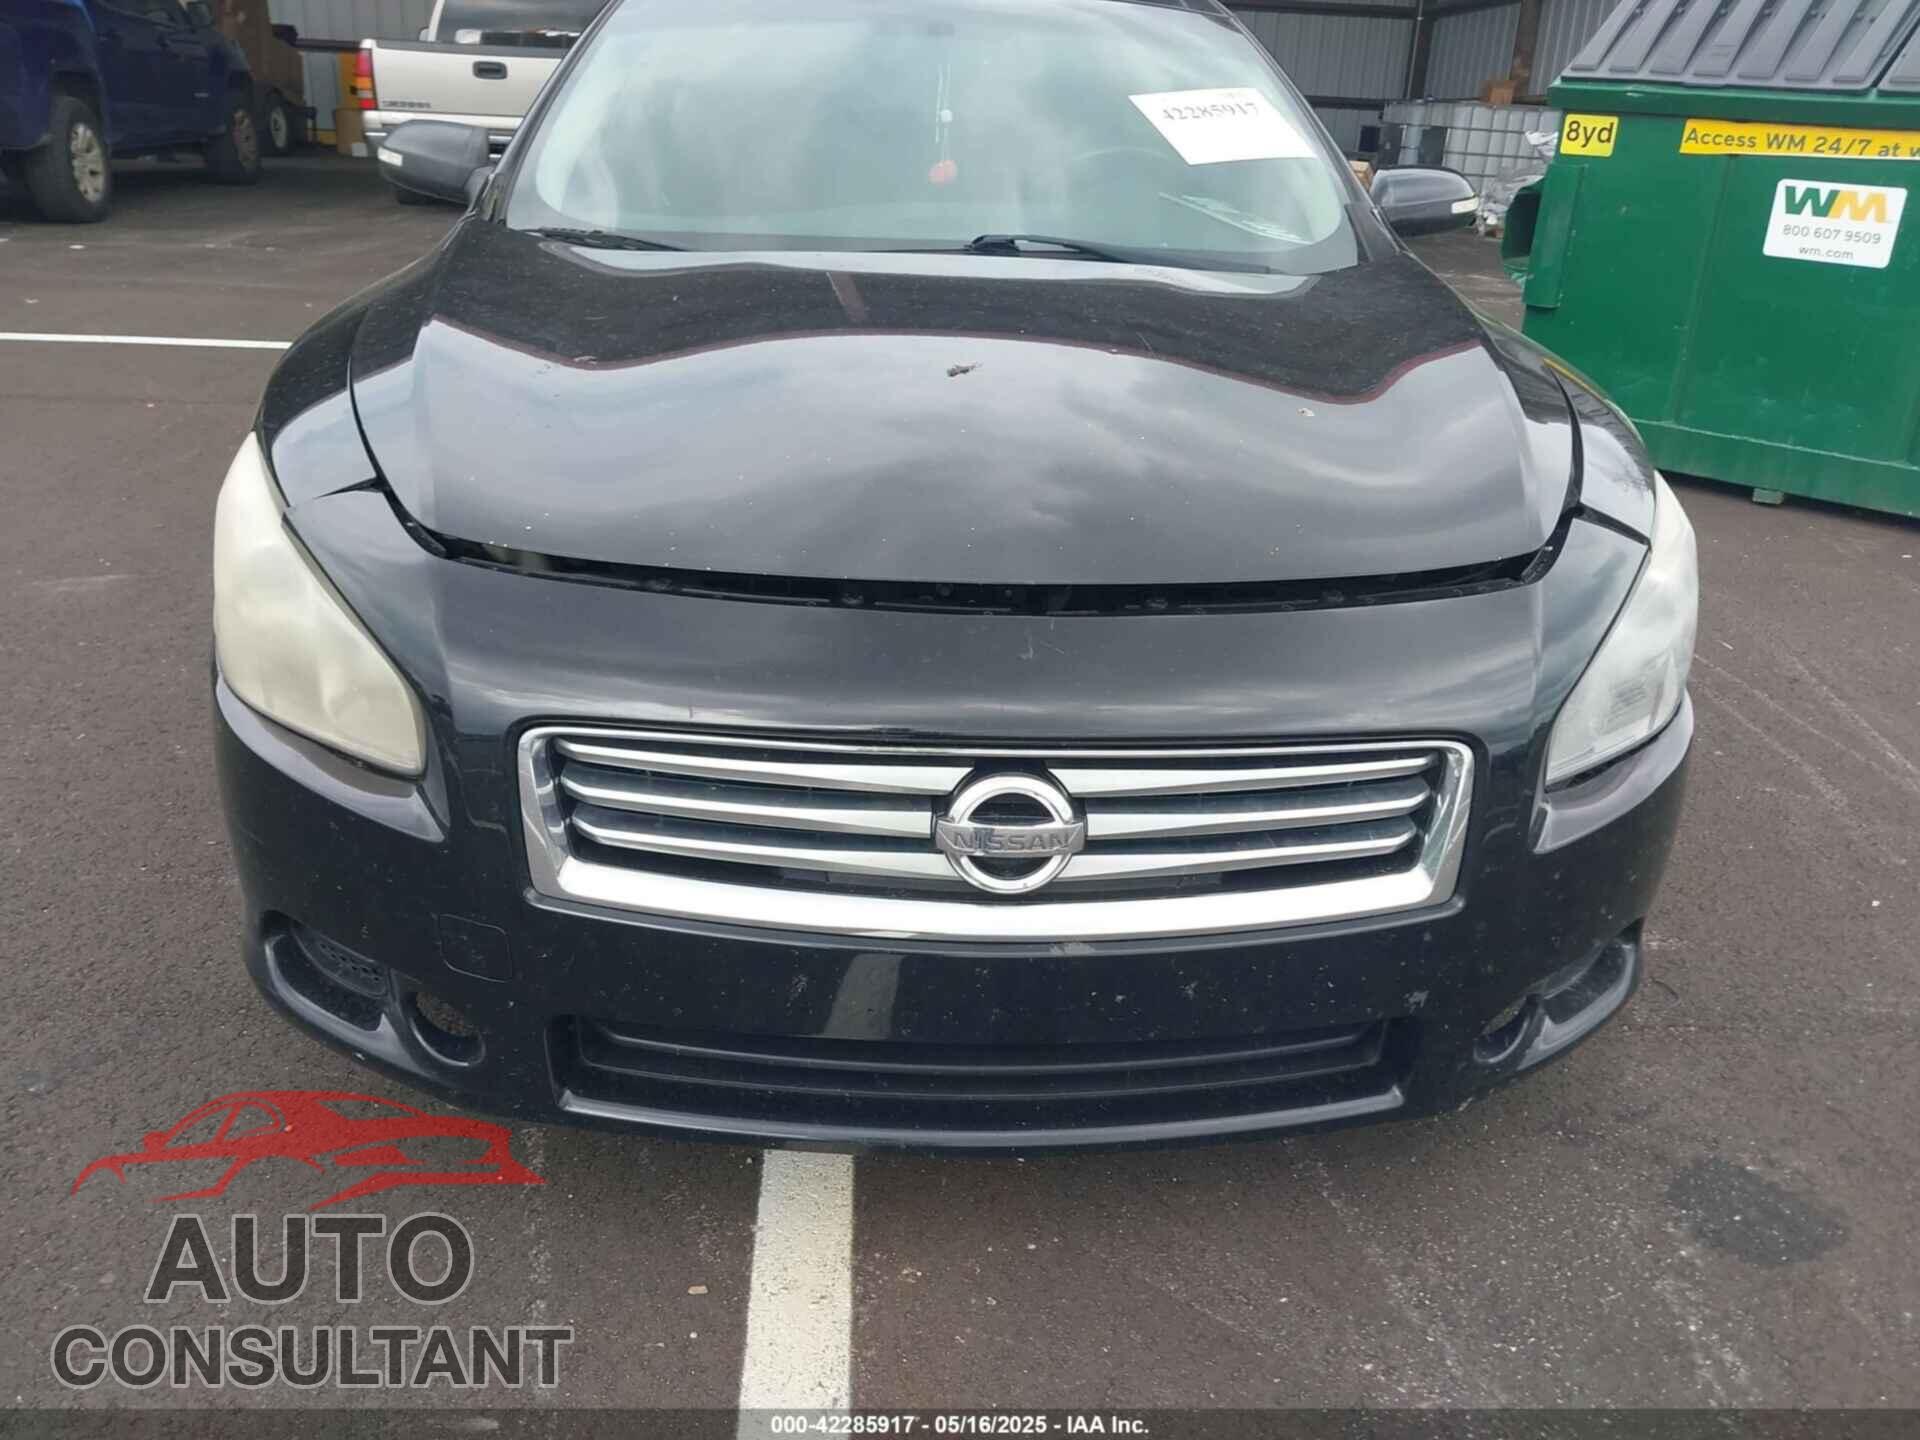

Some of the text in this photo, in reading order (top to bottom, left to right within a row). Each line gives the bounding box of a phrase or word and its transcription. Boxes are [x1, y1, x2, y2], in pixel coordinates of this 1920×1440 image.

[1566, 120, 1615, 148] 8yd
[1684, 127, 1757, 148] Access
[1766, 132, 1807, 151] WM
[1812, 136, 1873, 156] 24/7
[1877, 143, 1900, 157] at
[1784, 185, 1888, 225] WM
[1783, 224, 1881, 245] 800 607 9509
[1798, 246, 1855, 261] wm.com
[953, 831, 1070, 851] NISSAN
